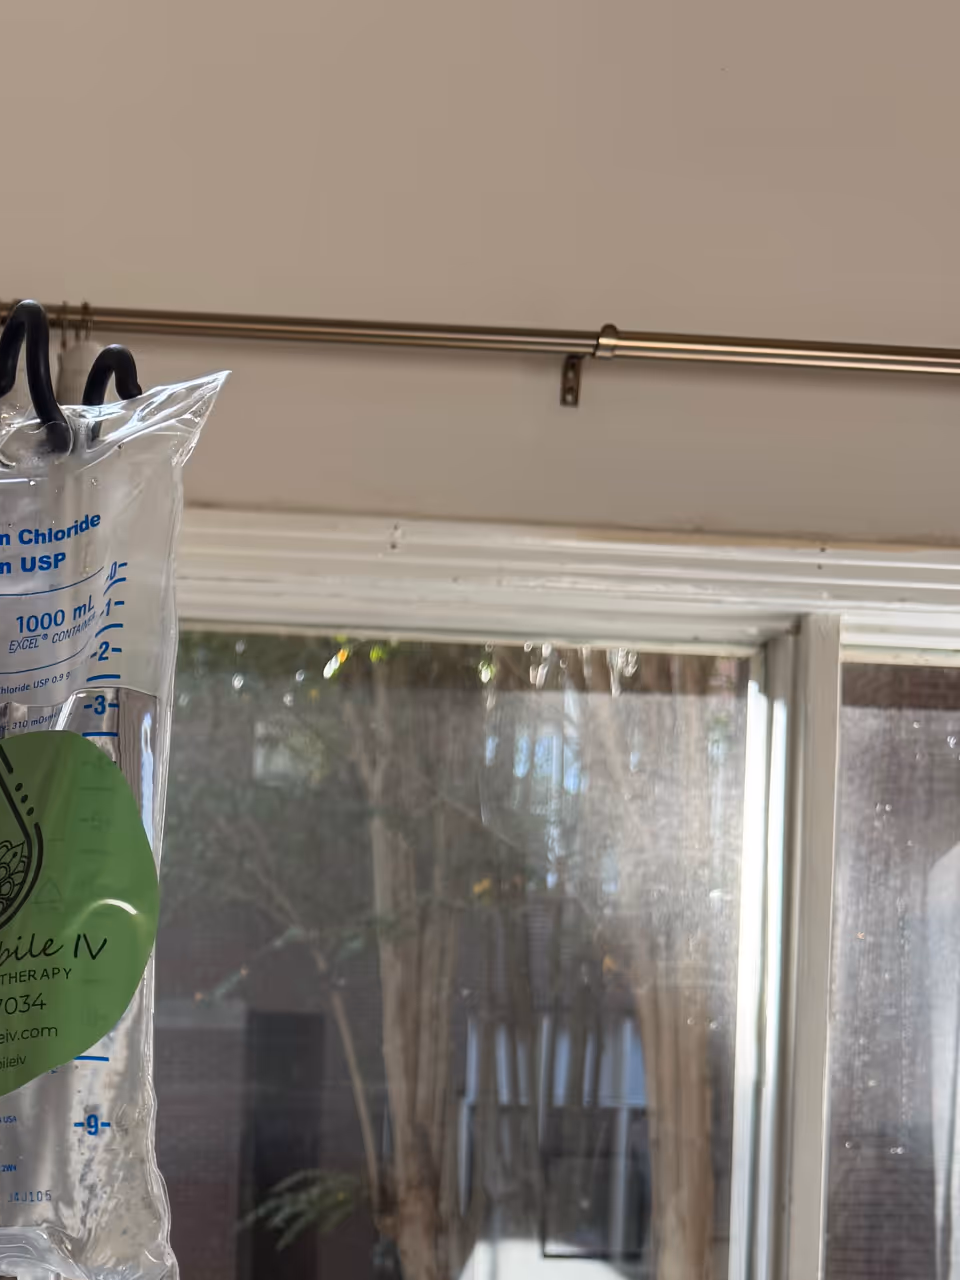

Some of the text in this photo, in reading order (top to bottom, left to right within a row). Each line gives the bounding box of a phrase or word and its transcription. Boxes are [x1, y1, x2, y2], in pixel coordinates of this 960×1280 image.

[18, 513, 101, 545] Chloride
[20, 552, 66, 573] USP
[16, 594, 95, 634] 1000 mL
[33, 678, 50, 689] USP
[52, 673, 64, 684] 0.9
[11, 721, 28, 730] 310
[73, 932, 108, 960] IV
[0, 967, 72, 986] THERAPY
[3, 1115, 18, 1124] USA
